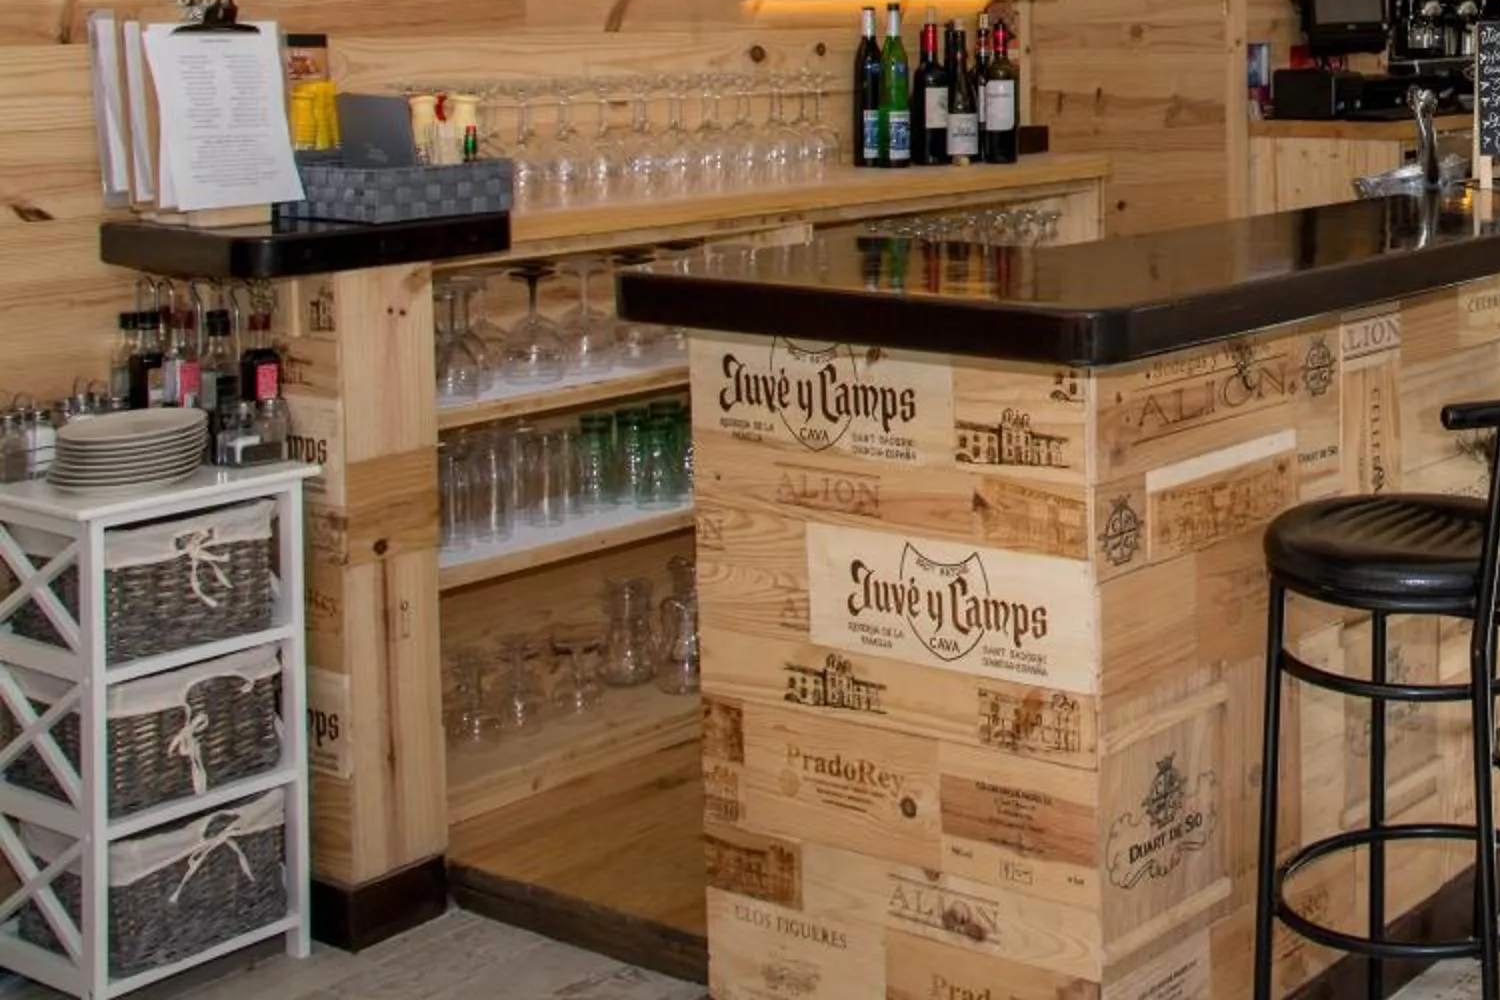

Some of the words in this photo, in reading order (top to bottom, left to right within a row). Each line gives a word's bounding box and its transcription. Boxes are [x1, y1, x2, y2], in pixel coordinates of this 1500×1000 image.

[1342, 318, 1400, 352] LION
[719, 354, 790, 412] Juvé
[796, 379, 813, 425] y
[817, 363, 916, 433] Camps
[800, 427, 829, 441] CAVA
[775, 472, 881, 510] ALION
[848, 559, 919, 618] Juvé
[927, 590, 943, 633] y
[948, 576, 1048, 648] Camps
[929, 636, 961, 653] CAVA
[784, 742, 905, 798] PradoRey
[735, 904, 771, 929] CLOS
